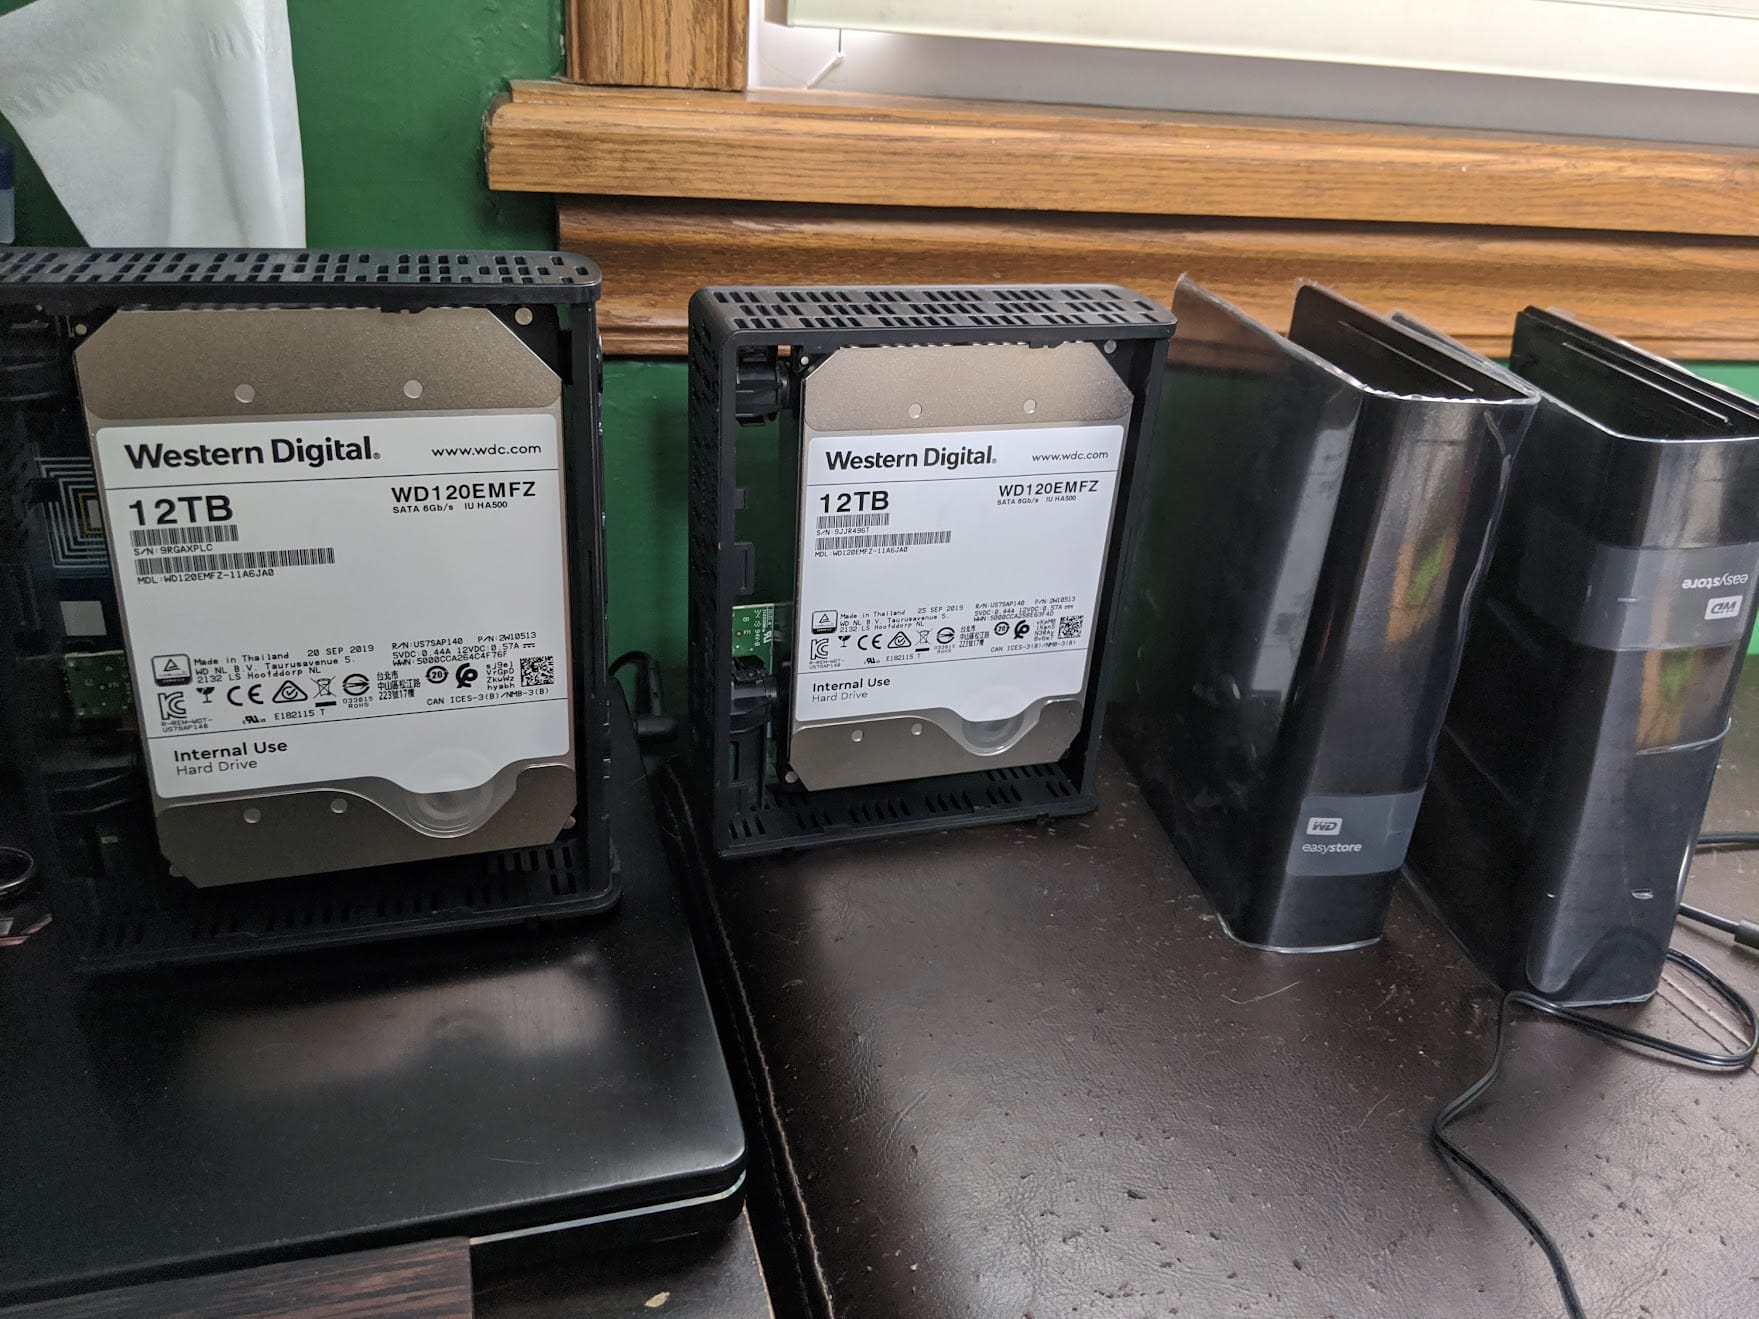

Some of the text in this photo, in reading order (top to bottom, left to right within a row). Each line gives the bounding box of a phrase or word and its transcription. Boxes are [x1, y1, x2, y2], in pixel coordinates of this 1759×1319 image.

[124, 443, 264, 469] Western
[432, 444, 542, 457] www.wdc.com
[1032, 451, 1108, 462] www.wdc.com
[826, 451, 918, 470] Western
[391, 481, 536, 503] WD120EMFZ
[999, 480, 1099, 497] WD120EMFZ
[129, 495, 234, 526] 12TB
[393, 505, 420, 514] SATA
[423, 503, 454, 512] 6Gb/s
[477, 501, 508, 509] HA500
[820, 490, 889, 514] 12TB
[997, 498, 1016, 506] SATA
[1682, 572, 1748, 589] easystore
[194, 652, 289, 666] Made in Thailand
[307, 644, 374, 657] 20 SEP 2019
[196, 667, 209, 676] WD
[214, 666, 228, 674] NL
[266, 658, 338, 670] Taurusavenue
[197, 666, 322, 684] 2132 LS Hoofddorp NL
[813, 677, 891, 692] Internal Use
[427, 698, 444, 706] CAN
[812, 690, 868, 702] Hard Drive
[174, 740, 288, 762] Internal Use
[176, 758, 258, 776] Hard Drive
[1302, 843, 1362, 854] easystore
